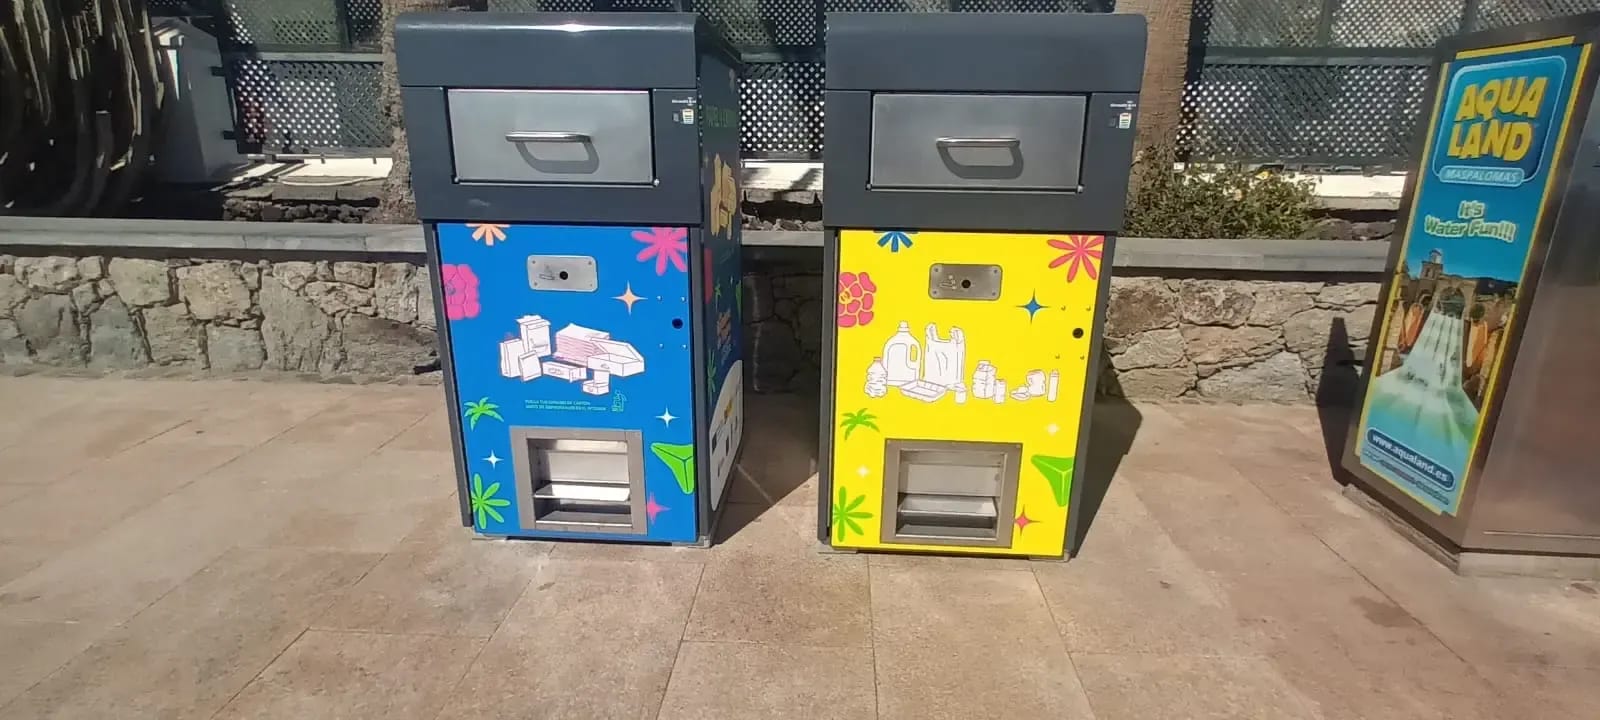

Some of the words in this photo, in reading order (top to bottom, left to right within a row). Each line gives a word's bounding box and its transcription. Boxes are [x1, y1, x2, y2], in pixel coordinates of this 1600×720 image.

[1454, 77, 1548, 121] AQUA
[1447, 119, 1533, 162] LAND
[1444, 168, 1520, 183] MASPALOMAS
[1458, 200, 1485, 219] It's
[1424, 215, 1468, 238] Water
[1468, 218, 1517, 243] Fun!!!
[1372, 434, 1449, 482] www.aqualand.es
